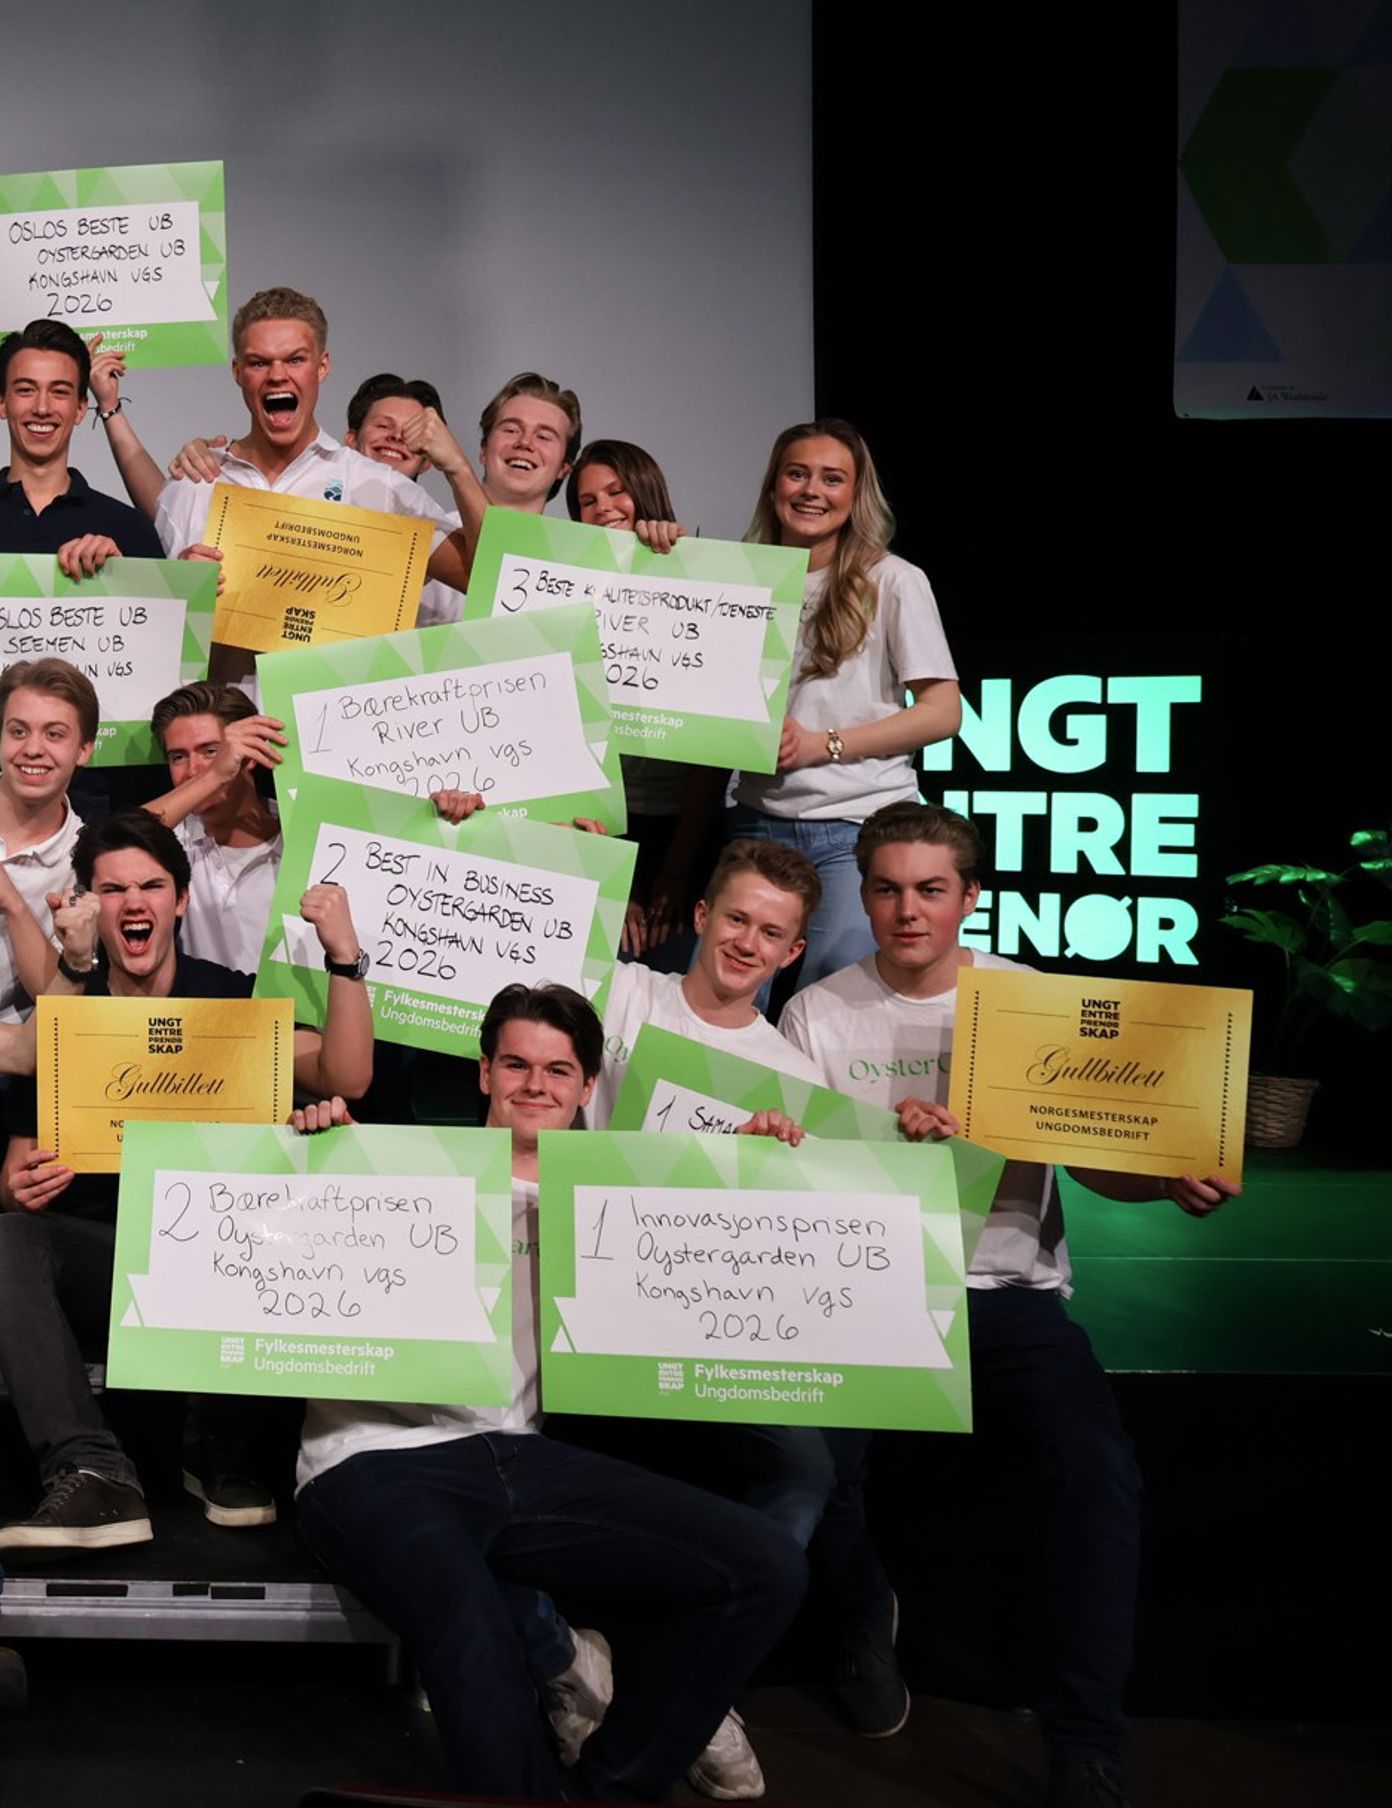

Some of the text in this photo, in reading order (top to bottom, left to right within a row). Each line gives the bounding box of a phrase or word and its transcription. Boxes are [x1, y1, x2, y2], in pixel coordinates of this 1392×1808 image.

[9, 219, 67, 244] OSLOS
[77, 216, 130, 236] BESTE
[149, 213, 173, 231] UB
[38, 239, 186, 264] OYSTERGARDEN UB
[28, 266, 163, 291] KONGSHAVN VGS
[47, 293, 112, 317] 2026
[266, 533, 363, 557] NORGESMESTERSKAP
[274, 521, 360, 544] UNGDOMSBEDRIFT
[501, 568, 530, 612] 3
[535, 571, 574, 596] BESTE
[51, 606, 104, 627] BESTE
[119, 607, 148, 625] UB
[286, 607, 316, 618] SKAP
[281, 631, 311, 643] UNGT
[283, 622, 313, 634] ENTRE
[672, 623, 700, 640] UB
[4, 635, 124, 653] SEEMEN UB
[107, 664, 133, 677] VGS
[606, 665, 659, 690] 026
[372, 707, 500, 745] River UB
[906, 675, 1203, 774] NGT
[348, 740, 533, 783] Kongshavn vgs
[939, 791, 1199, 878] TRE
[320, 842, 554, 906] 2 BEST IN BUSINESS
[387, 884, 573, 939] OYSTERGARDEN UB
[382, 912, 536, 964] KONGSHAVN VGS
[959, 890, 1199, 966] ENØR
[376, 941, 456, 980] 2026
[384, 990, 486, 1022] Fylkesmestersk
[1080, 1010, 1120, 1020] ENTRE
[1082, 998, 1120, 1011] UNGT
[148, 1017, 182, 1027] UNGT
[148, 1028, 183, 1036] ENTRE
[381, 1008, 482, 1038] Ungdomsbedrif
[1079, 1027, 1119, 1039] SKAP
[148, 1044, 183, 1054] SKAP
[1026, 1044, 1164, 1089] Gullbillett
[105, 1062, 225, 1101] Gullbillett
[1030, 1105, 1158, 1127] NORGESMESTERSKAP
[1036, 1122, 1150, 1141] UNGDOMSBEDRIFT
[158, 1181, 199, 1242] 2
[631, 1195, 886, 1239] Innovasjonsprisen
[410, 1224, 458, 1255] UB
[637, 1232, 891, 1275] Oystergarden UB
[213, 1252, 406, 1294] Kongshavn vgs
[258, 1290, 361, 1317] 2026
[635, 1272, 774, 1310] Kongshavn
[699, 1311, 800, 1343] 2026
[255, 1338, 394, 1359] Fylkesmesterskap
[255, 1358, 375, 1376] Ungdomsbedrift
[695, 1365, 844, 1386] Fylkesmesterskap
[695, 1384, 825, 1404] Ungdomsbedrift
